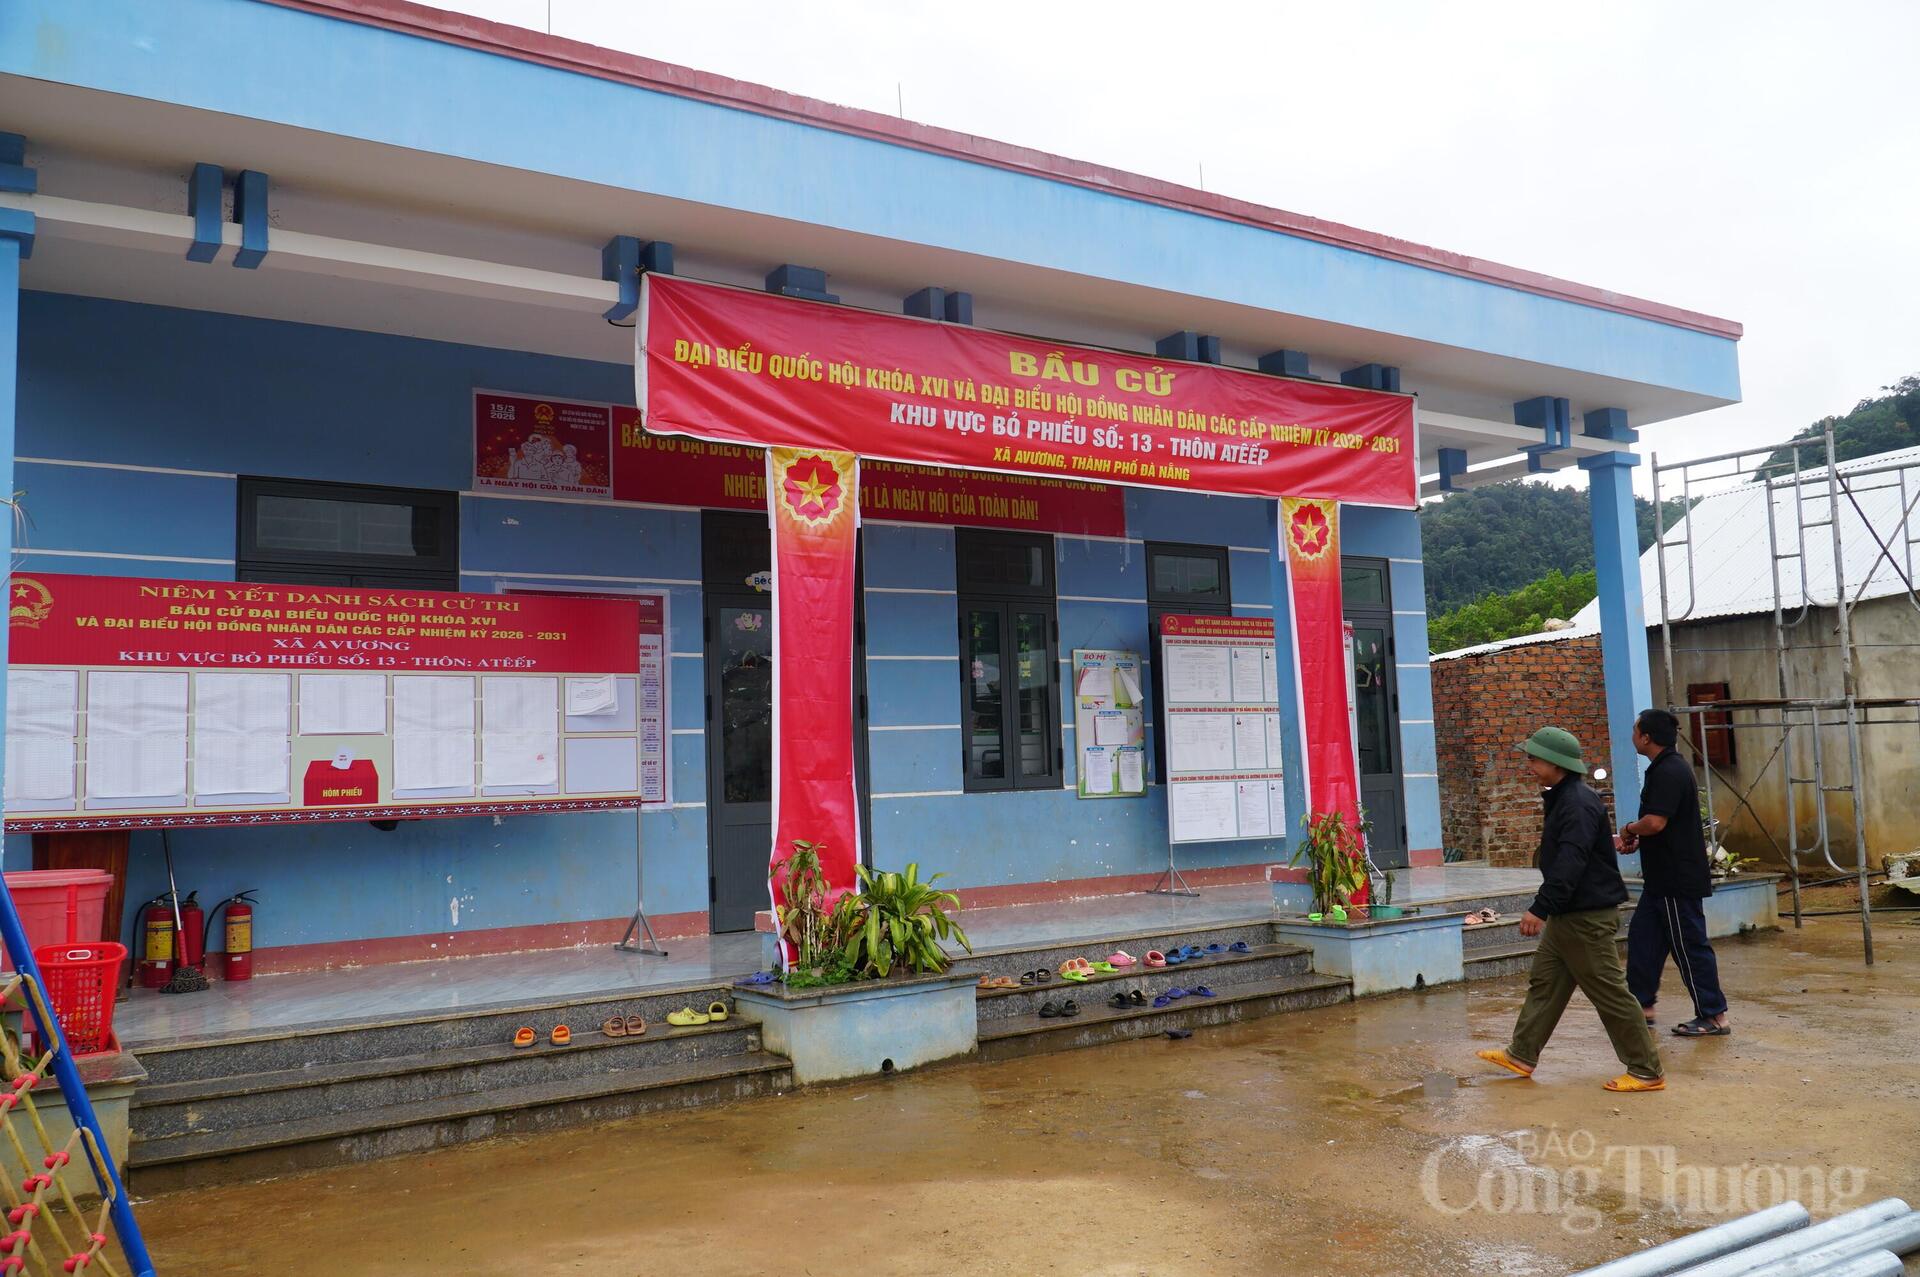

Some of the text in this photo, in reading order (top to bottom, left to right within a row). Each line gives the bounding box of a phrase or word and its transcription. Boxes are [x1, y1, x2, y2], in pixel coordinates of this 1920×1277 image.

[1009, 350, 1176, 397] BẦU CỬ
[490, 404, 515, 412] 15/3
[674, 339, 710, 369] ĐẠI
[715, 342, 763, 374] BIỂU
[769, 352, 823, 382] QUỐC
[828, 360, 861, 390] HỘI
[866, 367, 916, 394] KHÓA
[920, 375, 949, 399] XVI
[953, 378, 977, 402] VÀ
[981, 384, 1010, 409] ĐẠI
[1014, 383, 1052, 412] BIỂU
[1056, 392, 1083, 419] HỘI
[1086, 394, 1129, 422] ĐỒNG
[1132, 404, 1173, 428] NHÂN
[1177, 409, 1207, 432] DÂN
[1210, 413, 1237, 436] CÁC
[1239, 415, 1267, 440] CẤP
[1270, 424, 1312, 448] NHIỆM
[1313, 426, 1331, 447] KỲ
[1371, 436, 1400, 454] 2031
[490, 412, 516, 421] 2026
[890, 402, 937, 428] KHU
[943, 409, 986, 436] VỰC
[992, 411, 1021, 438] BỎ
[1026, 419, 1087, 445] PHIẾU
[1092, 424, 1124, 450] SỐ:
[1130, 433, 1152, 453] 13
[1170, 436, 1216, 461] THÔN
[1219, 441, 1270, 466] ATÊẾP
[993, 446, 1190, 481] XÃ AVƯƠNG, THÀNH PHỐ ĐÀ NẴNG
[874, 482, 890, 509] LÀ
[893, 485, 925, 511] NGÀY
[929, 488, 949, 518] HỘI
[952, 487, 976, 515] CỦA
[978, 492, 1009, 519] TOÀN
[1012, 495, 1039, 521] DÂN!
[139, 584, 521, 612] NIÊM YẾT DANH SÁCH CỬ TRI
[216, 605, 245, 617] CỬ
[248, 608, 281, 620] ĐẠI
[286, 607, 328, 620] BIỂU
[334, 609, 382, 622] QUỐC
[387, 612, 416, 625] HỘI
[421, 613, 466, 625] KHÓA
[471, 616, 497, 626] XVI
[75, 616, 99, 628] VÀ
[104, 617, 134, 630] ĐẠI
[139, 616, 179, 630] BIỂU
[183, 620, 212, 632] HỘI
[266, 622, 312, 633] NHÂN
[316, 624, 348, 634] DÂN
[352, 625, 382, 635] CÁC
[420, 627, 466, 639] NHIỆM
[470, 628, 487, 639] KỲ
[492, 630, 524, 640] 2026
[536, 632, 567, 641] 2031
[273, 637, 306, 649] XÃ
[119, 651, 170, 661] KHU
[177, 651, 225, 665] VỰC
[231, 651, 262, 664] BỎ
[267, 652, 332, 665] PHIẾU
[337, 652, 371, 666] SỐ:
[377, 656, 396, 666] 13
[411, 655, 472, 667] THÔN:
[476, 655, 537, 668] ATÊẾP
[322, 786, 363, 797] HÒM PHIẾU
